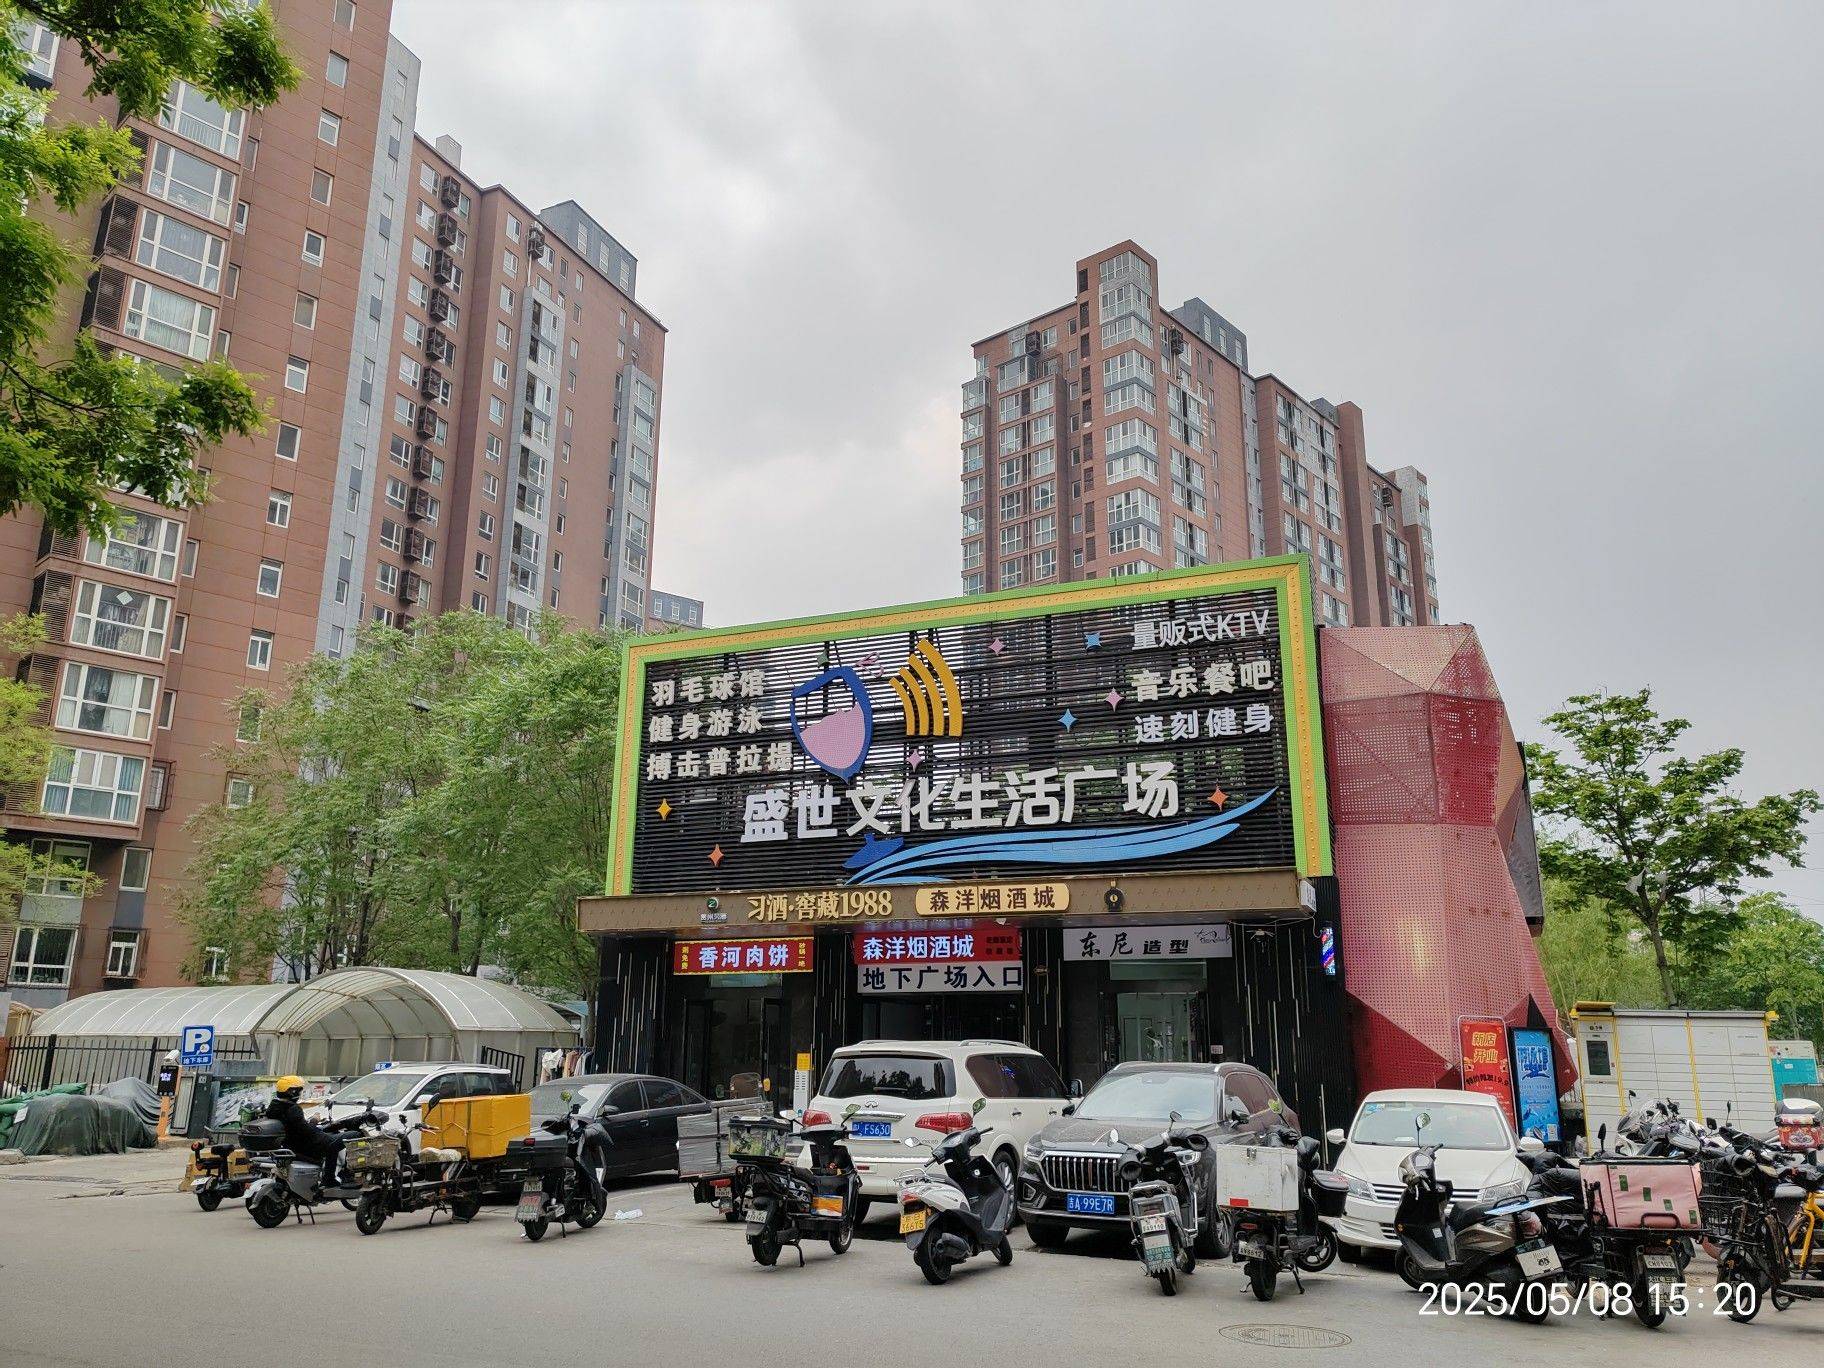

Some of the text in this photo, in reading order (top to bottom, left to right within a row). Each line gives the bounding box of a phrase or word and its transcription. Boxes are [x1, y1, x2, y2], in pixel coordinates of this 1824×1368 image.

[1131, 609, 1270, 651] 量贩式KTV
[651, 669, 766, 707] 羽毛球馆
[1132, 660, 1274, 702] 音乐餐吧
[648, 706, 764, 743] 健身游泳
[1134, 703, 1274, 744] 速刻健身
[739, 761, 1179, 844] 盛世文化生活广场
[747, 890, 893, 922] 习酒·窖藏1988
[929, 886, 1056, 913] 森洋烟酒城
[698, 944, 789, 969] 香河肉饼
[862, 934, 975, 961] 森洋烟酒城
[862, 965, 1023, 990] 地下广场入口
[1473, 1048, 1498, 1064] 开业
